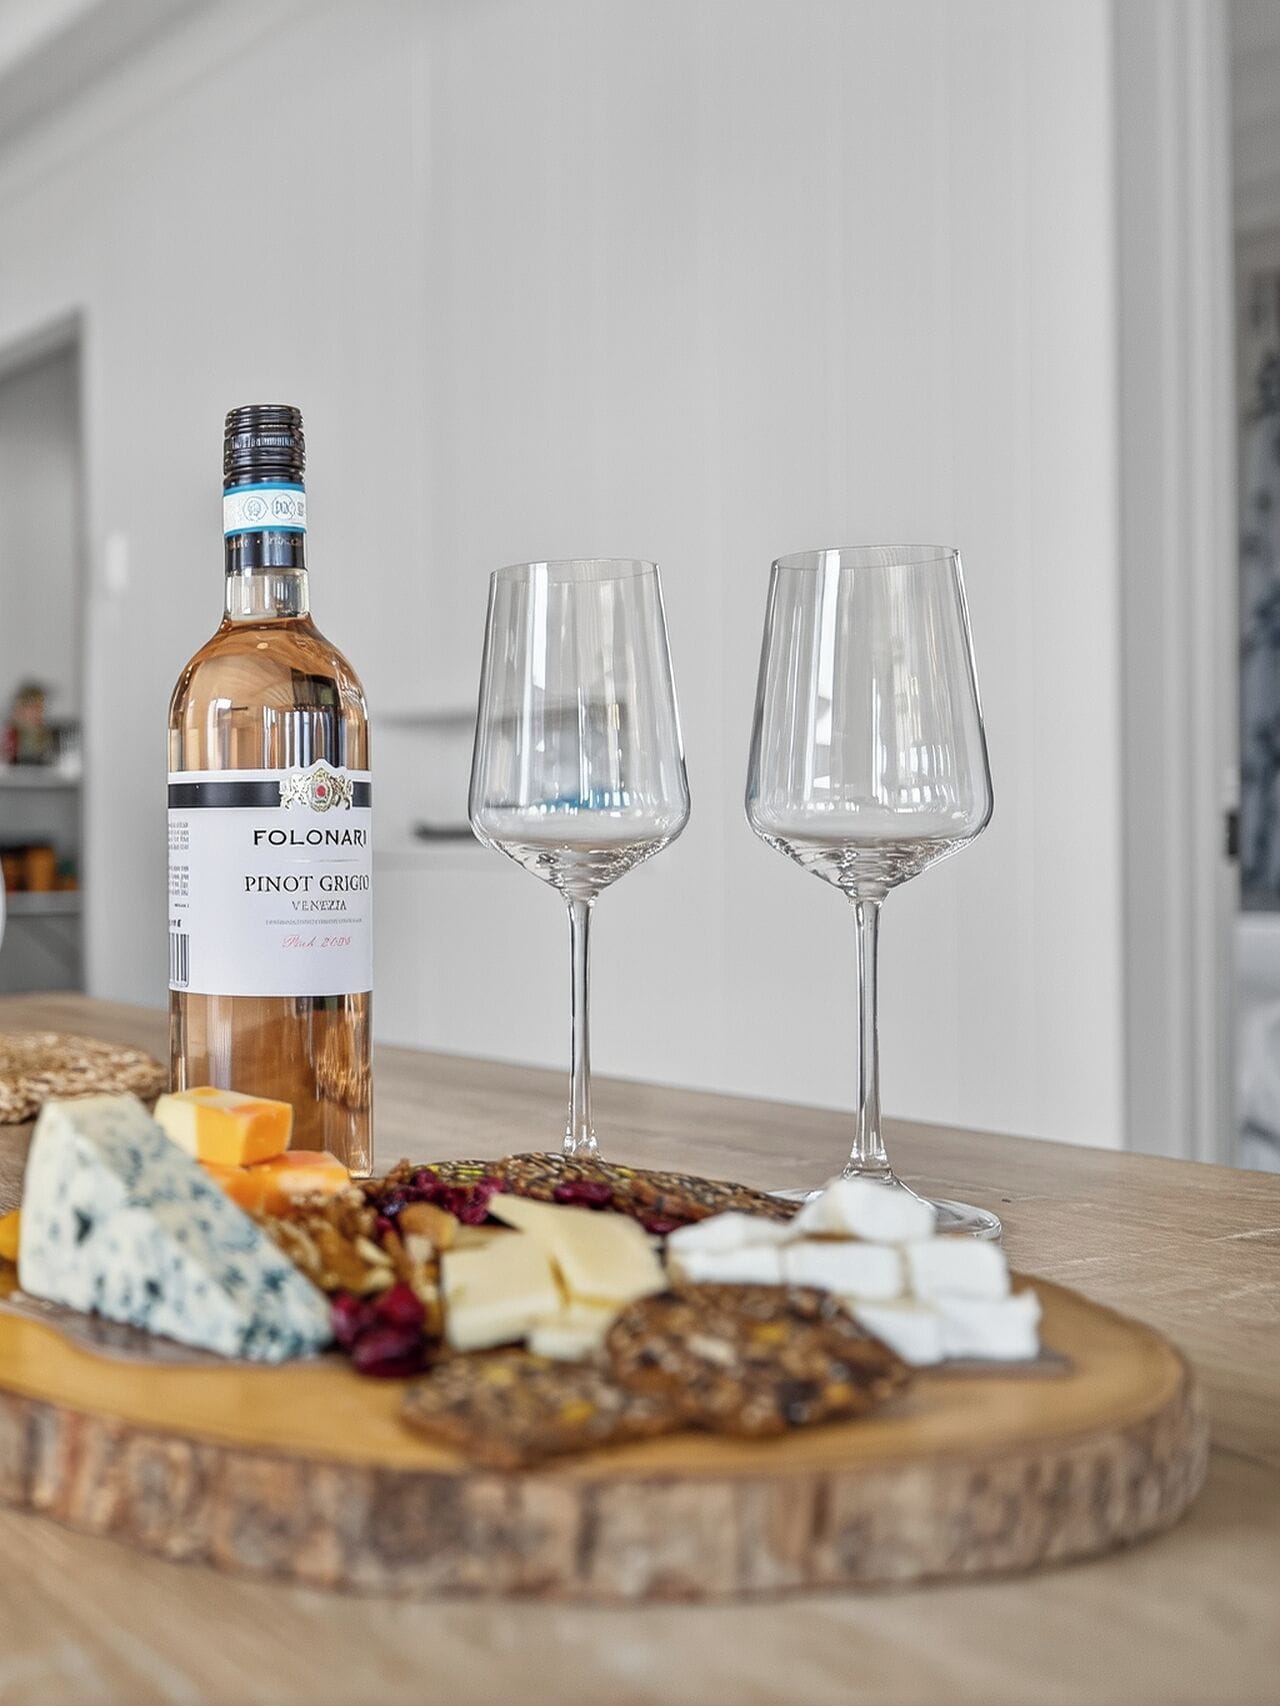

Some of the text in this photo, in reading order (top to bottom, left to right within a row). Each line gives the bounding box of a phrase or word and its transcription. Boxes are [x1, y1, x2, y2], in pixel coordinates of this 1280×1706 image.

[253, 829, 367, 848] FOLONARI
[245, 875, 313, 892] PINOT
[292, 900, 347, 911] VENEZIA
